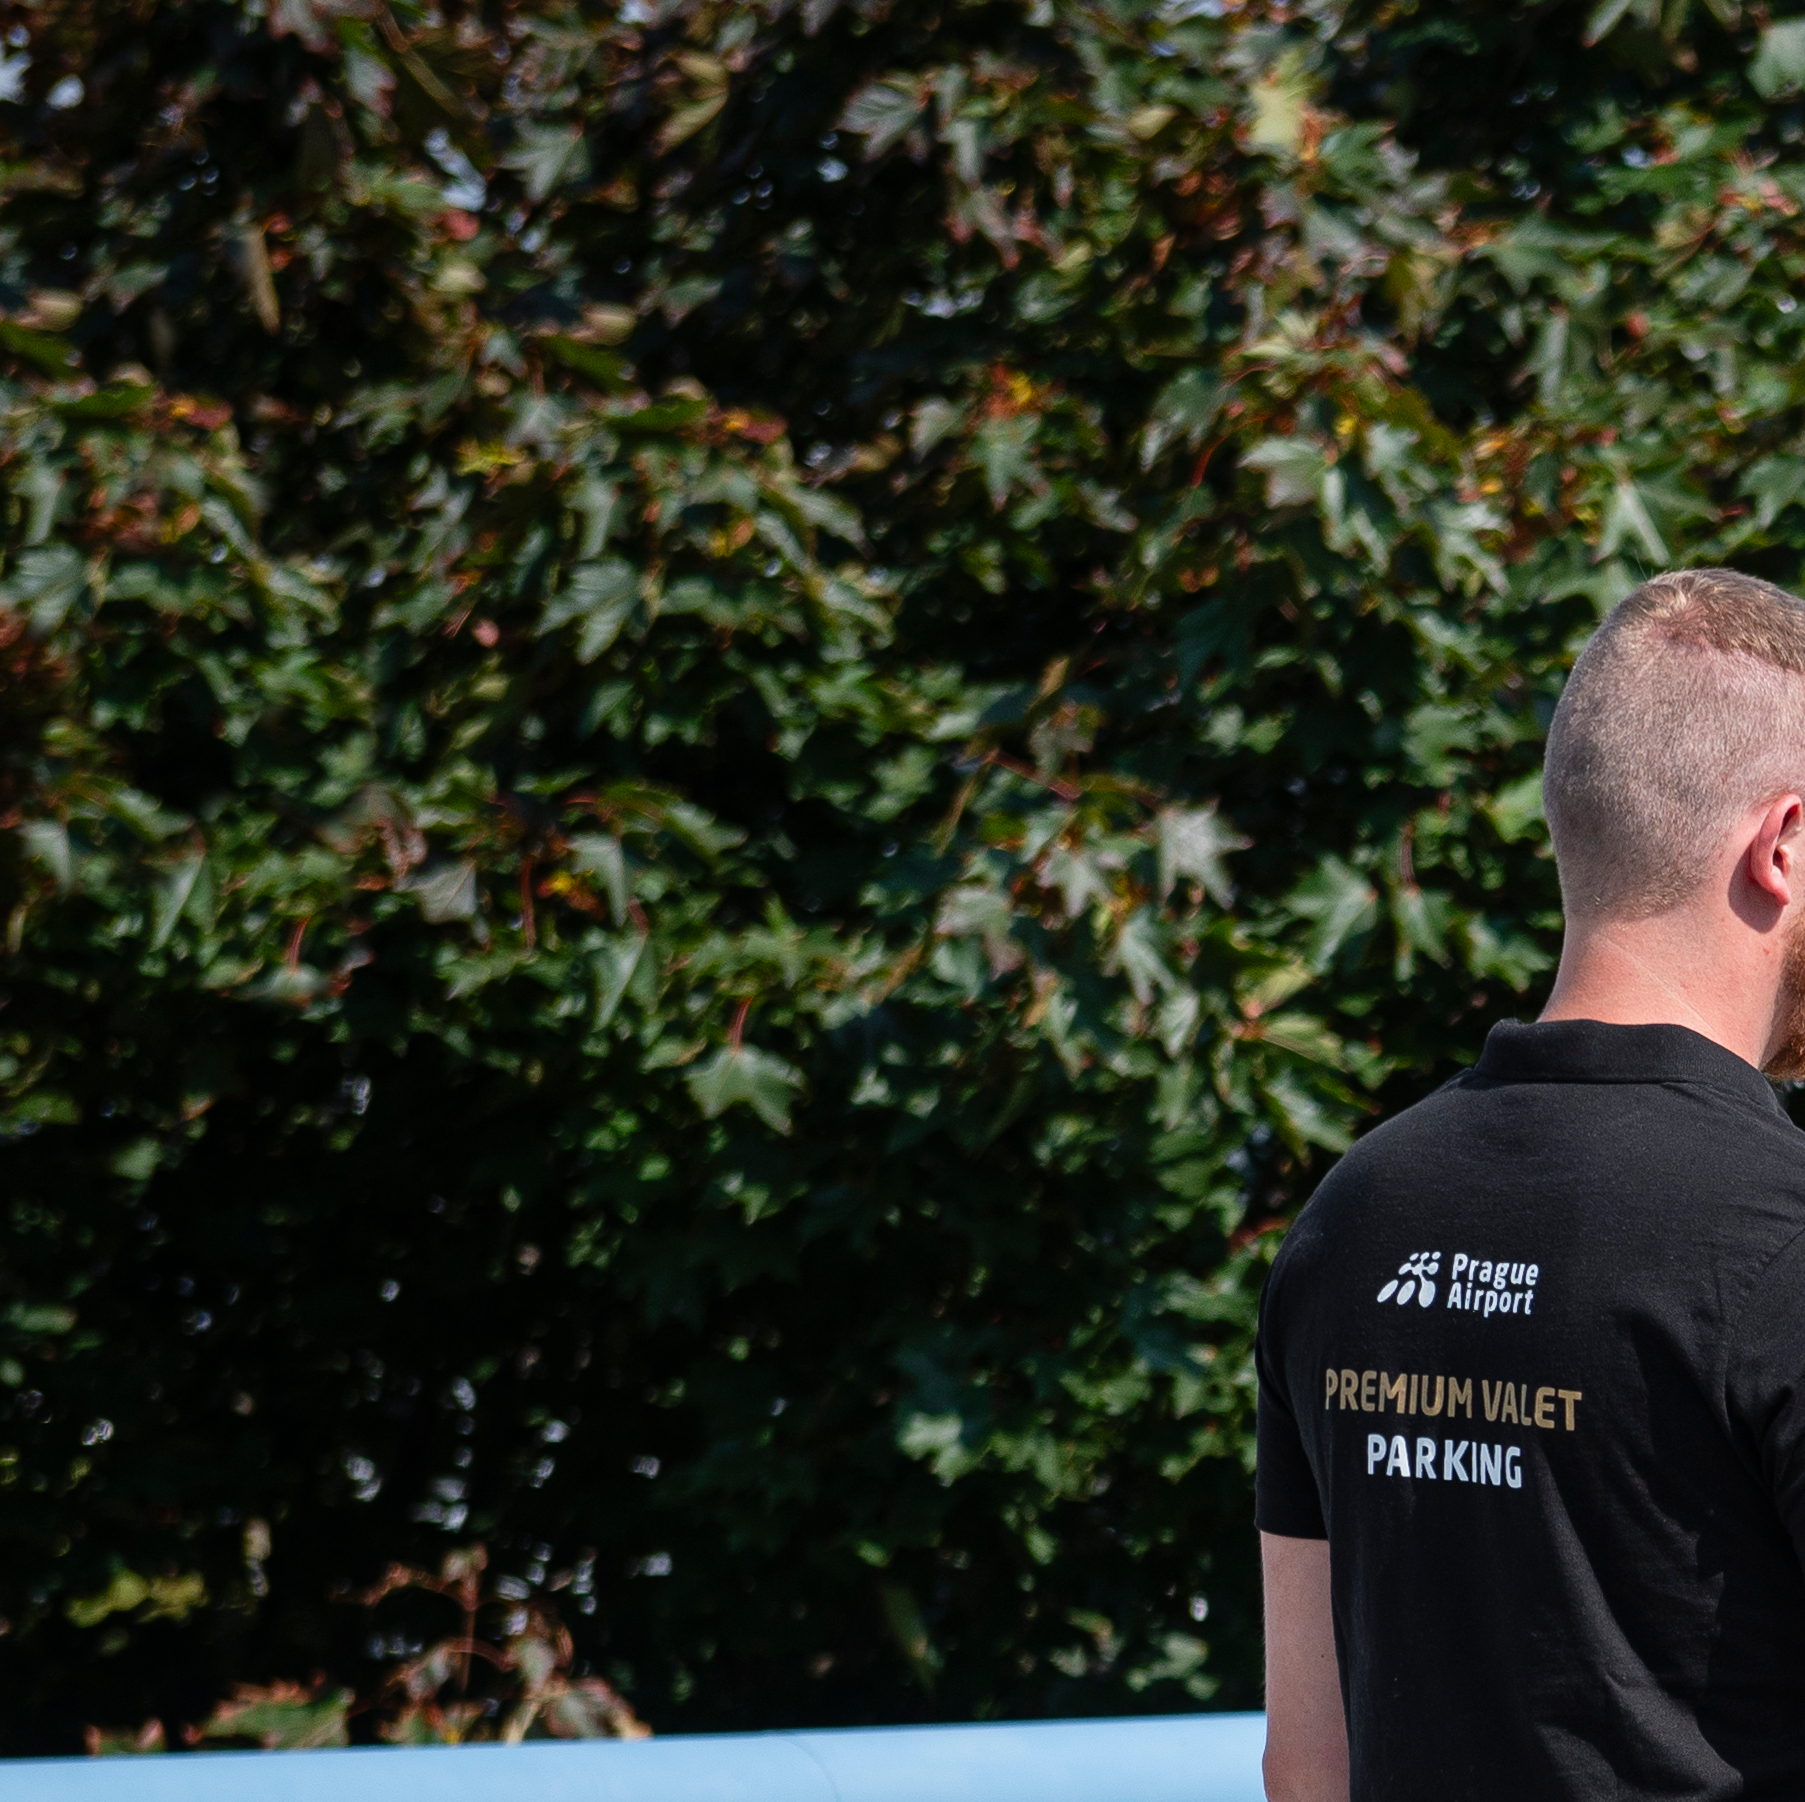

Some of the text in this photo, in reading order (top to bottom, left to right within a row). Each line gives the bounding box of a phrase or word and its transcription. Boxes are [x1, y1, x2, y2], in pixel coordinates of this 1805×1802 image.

[1451, 1253, 1539, 1288] Prague
[1447, 1282, 1534, 1318] Airport
[1325, 1368, 1582, 1431] PREMIUM VALET
[1367, 1433, 1522, 1489] PARKING
